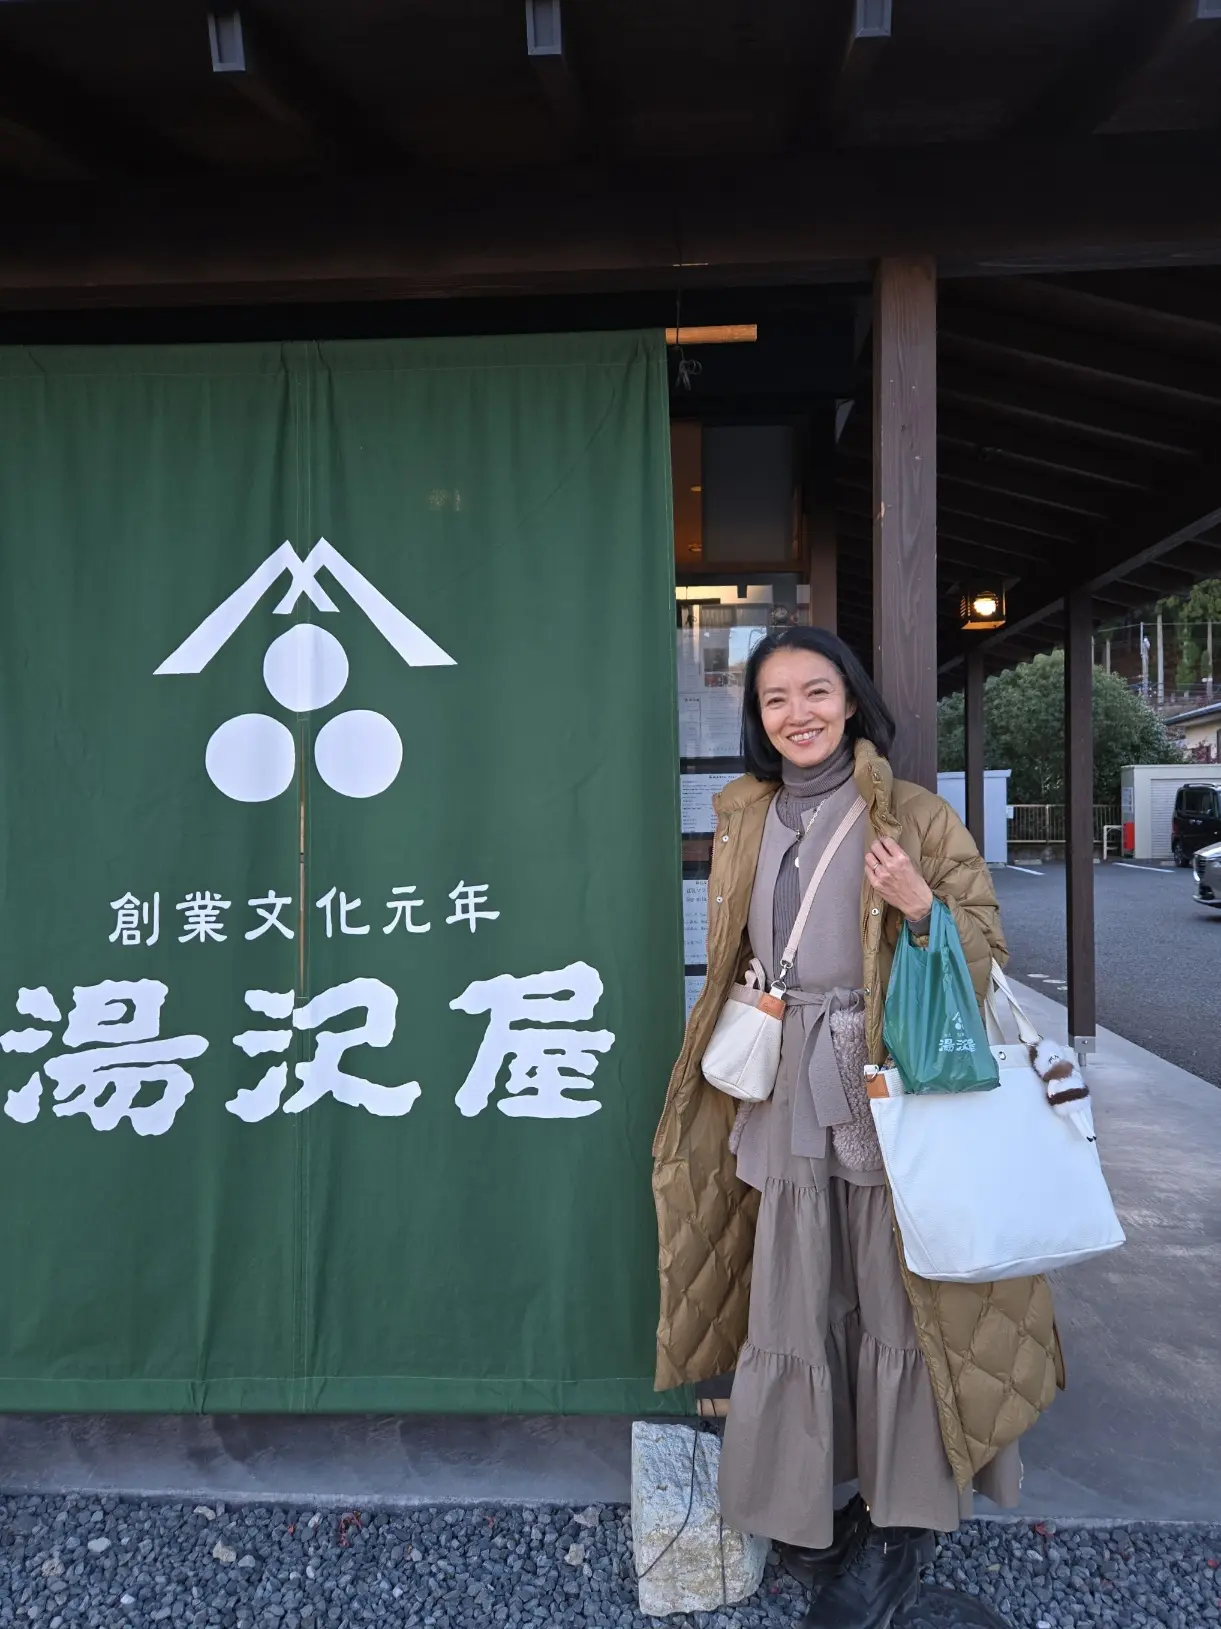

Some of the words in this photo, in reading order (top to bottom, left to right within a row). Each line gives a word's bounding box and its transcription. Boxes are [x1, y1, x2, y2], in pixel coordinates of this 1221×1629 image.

[109, 880, 500, 946] 創業文化元年
[0, 961, 615, 1136] 湯沢屋
